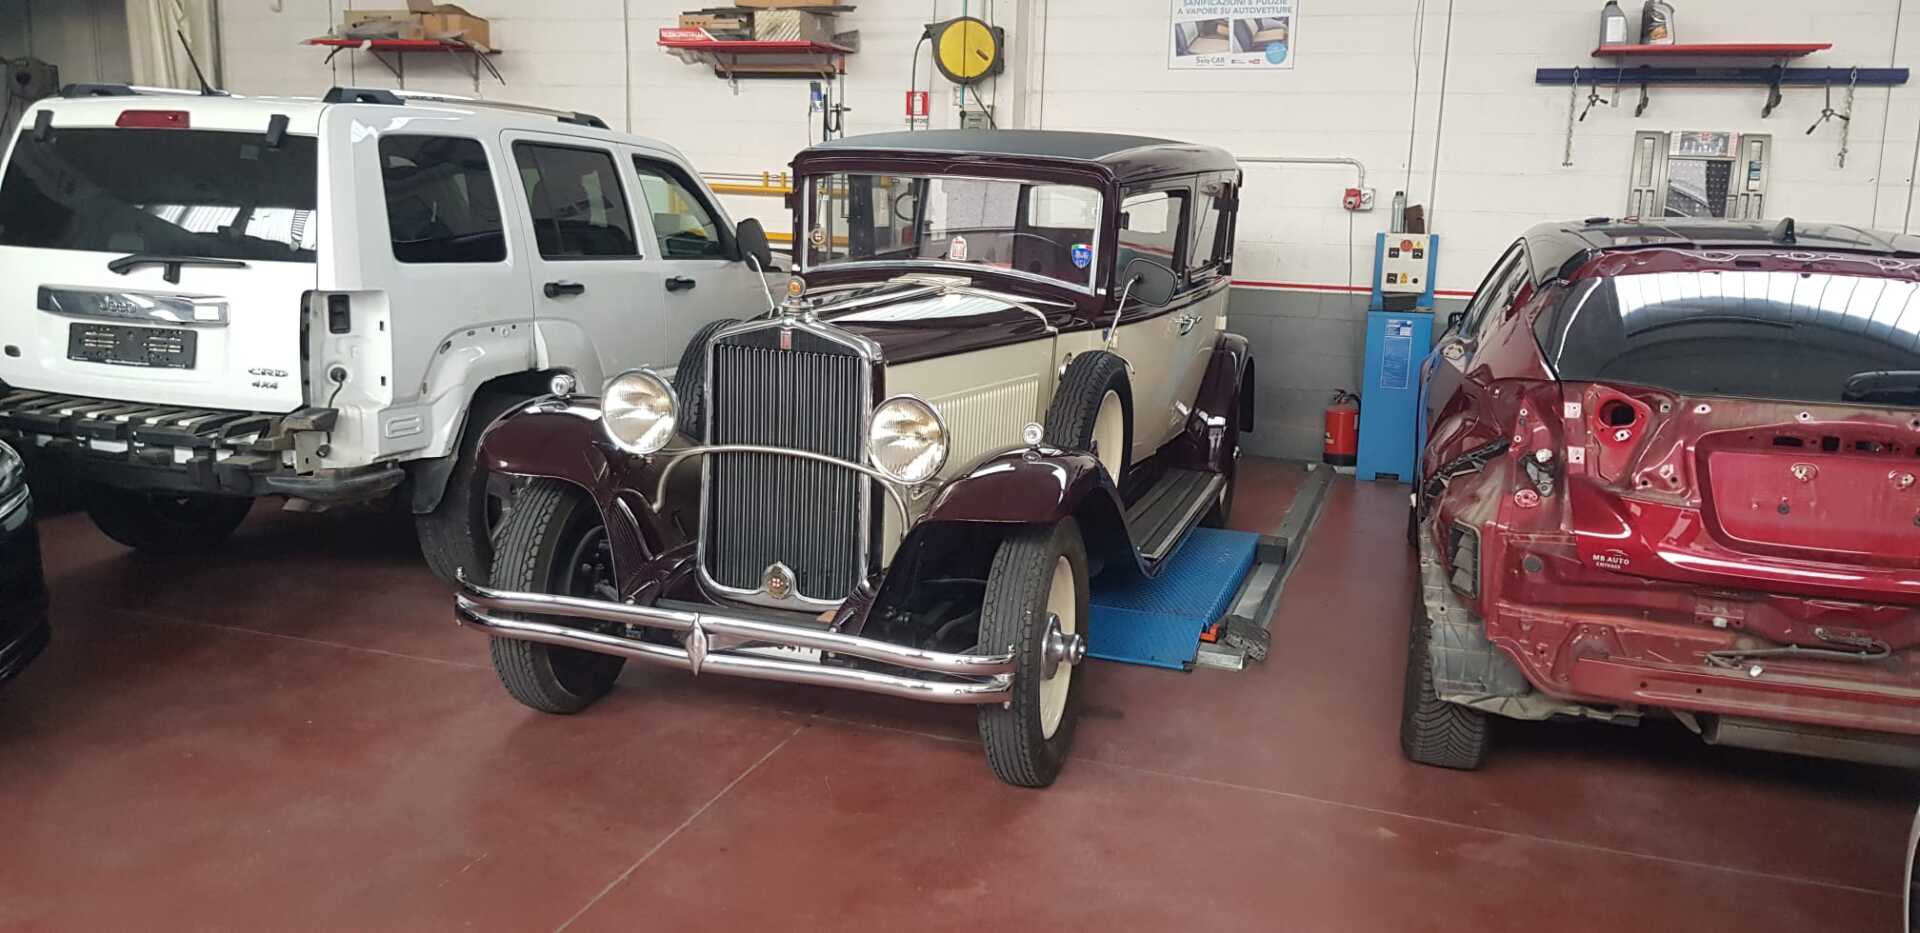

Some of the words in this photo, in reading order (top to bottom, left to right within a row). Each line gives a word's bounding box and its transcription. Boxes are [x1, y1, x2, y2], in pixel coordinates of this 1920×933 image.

[1185, 7, 1217, 15] VAPORE
[1233, 6, 1292, 14] AUTOVETTURE
[99, 295, 137, 314] Jeep
[247, 367, 289, 378] CRD
[1592, 553, 1605, 561] MB
[1606, 556, 1630, 565] AUTO
